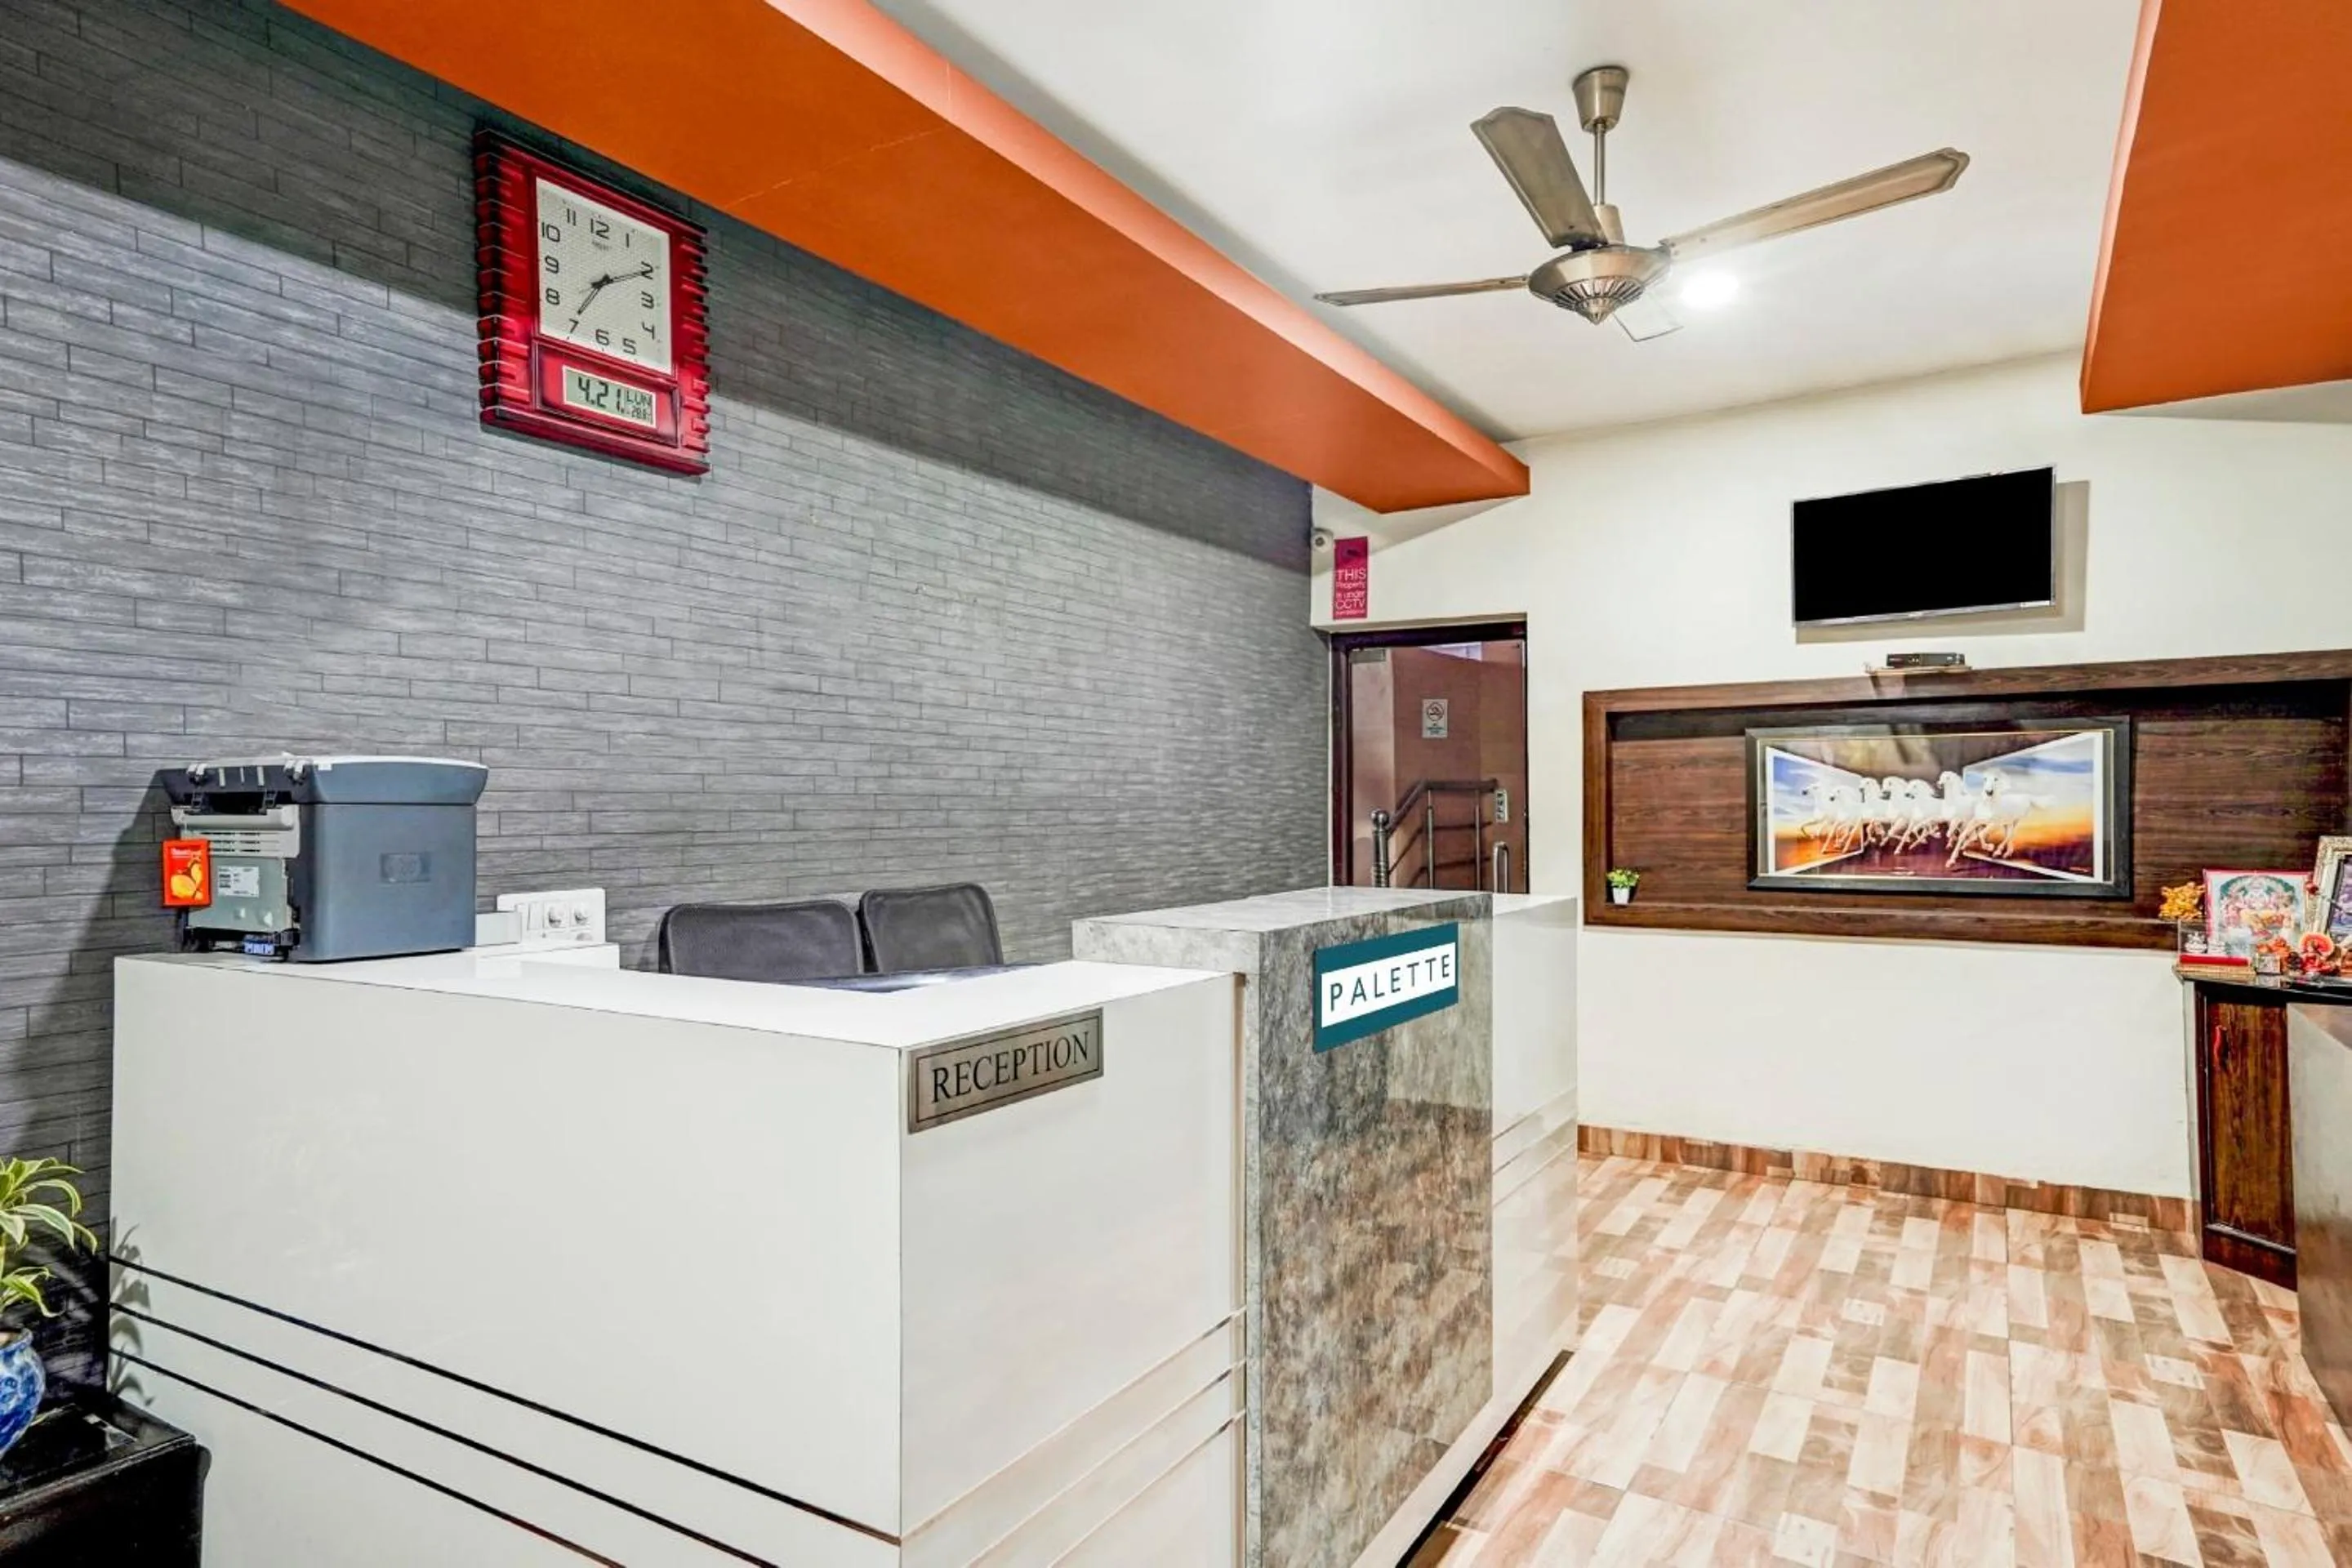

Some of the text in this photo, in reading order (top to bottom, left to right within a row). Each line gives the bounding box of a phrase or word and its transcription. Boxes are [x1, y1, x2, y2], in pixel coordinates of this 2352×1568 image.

[567, 208, 577, 226] 11
[541, 221, 561, 243] 10
[590, 218, 610, 239] 12
[626, 233, 630, 248] 1
[545, 255, 559, 274] 9
[640, 261, 654, 280] 2
[546, 287, 561, 305] 8
[641, 291, 655, 309] 3
[568, 318, 579, 333] 7
[642, 321, 656, 340] 4
[595, 328, 610, 346] 6
[623, 337, 637, 355] 5
[1336, 568, 1366, 581] THIS
[1335, 599, 1365, 610] CCTV
[1330, 954, 1450, 1012] PALETTE
[931, 1031, 1089, 1103] RECEPTION
